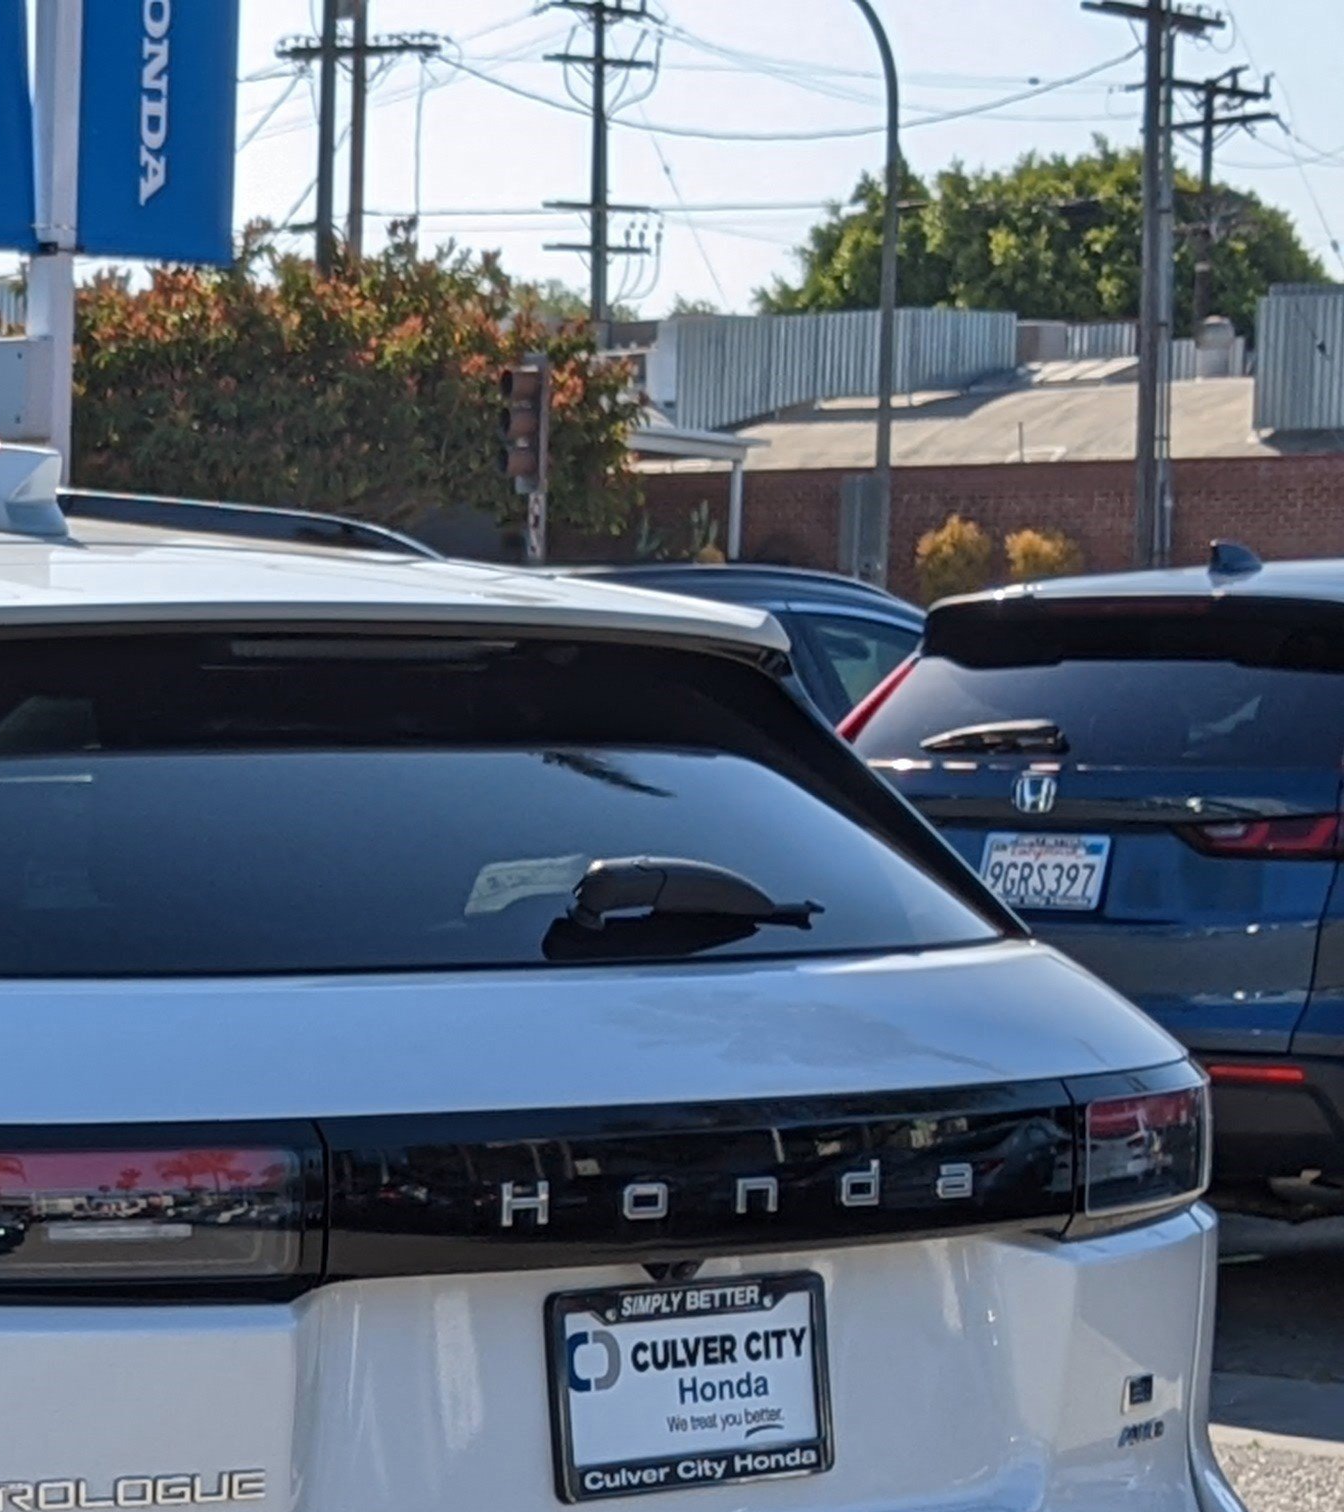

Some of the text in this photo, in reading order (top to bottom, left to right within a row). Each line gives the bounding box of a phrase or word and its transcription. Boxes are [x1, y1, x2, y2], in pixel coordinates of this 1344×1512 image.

[990, 861, 1096, 898] 9GRS397
[501, 1158, 974, 1228] Honda
[621, 1285, 760, 1317] SIMPLY BETTER
[631, 1326, 807, 1373] CULVER CITY
[679, 1372, 769, 1405] Honda
[667, 1415, 689, 1433] We
[691, 1411, 717, 1430] treat
[720, 1413, 743, 1433] you
[584, 1448, 818, 1491] Culver City Honda
